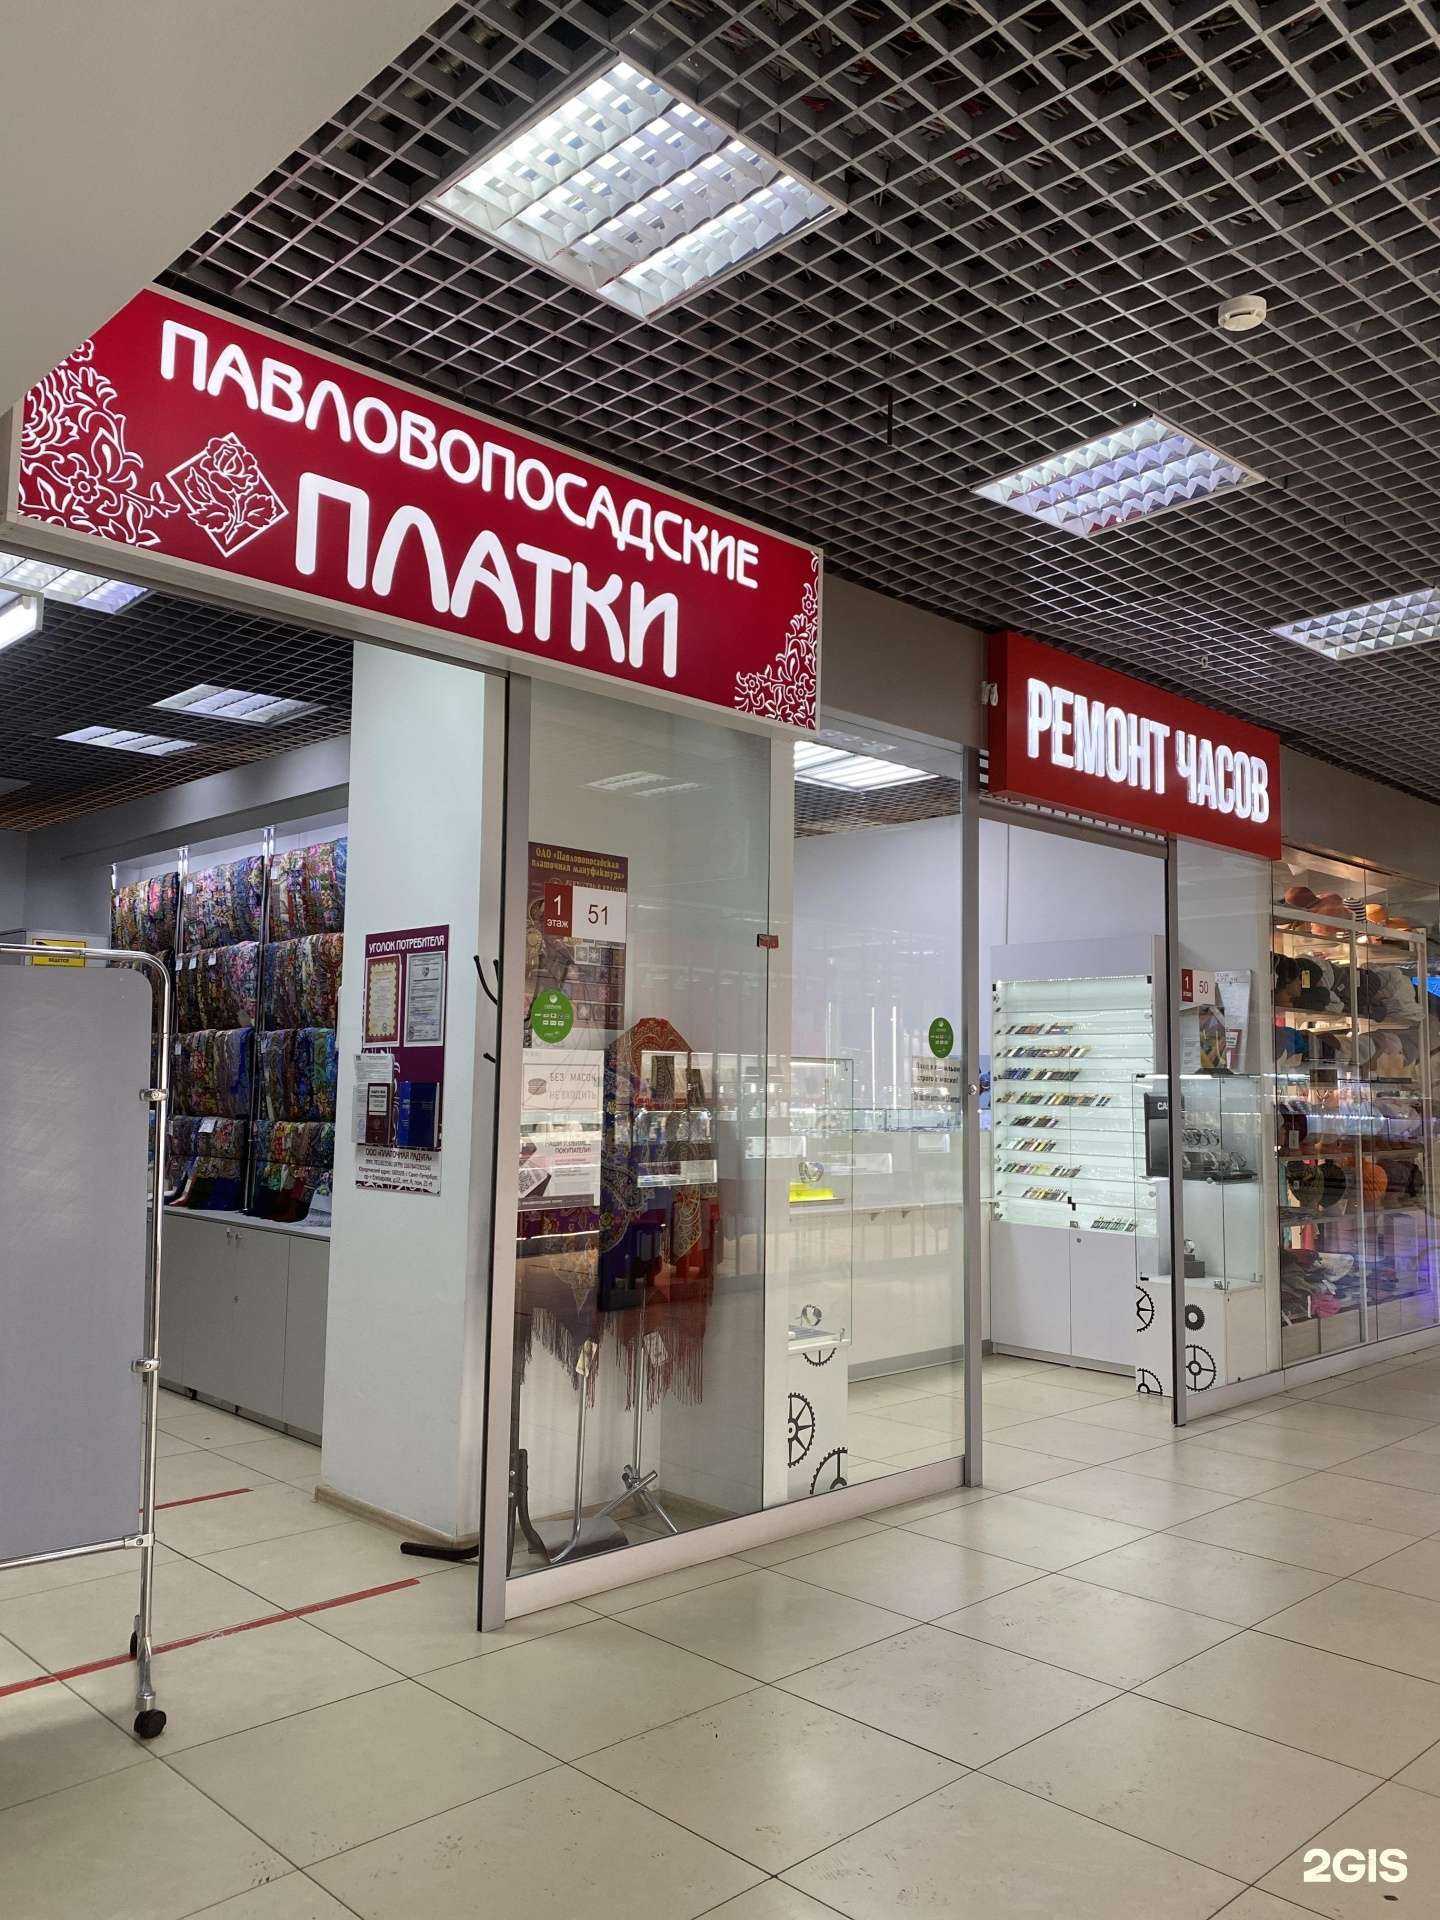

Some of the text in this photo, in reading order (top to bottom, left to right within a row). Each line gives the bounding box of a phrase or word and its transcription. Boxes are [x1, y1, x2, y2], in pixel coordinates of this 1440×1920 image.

[160, 319, 760, 590] ПАВЛОВОПОСАДСКИЕ
[294, 471, 679, 679] ПЛАТКИ
[1027, 677, 1271, 825] РЕМОНТ ЧАСОВ
[535, 847, 552, 859] ОАО
[553, 894, 562, 916] 1
[587, 903, 609, 926] 51
[546, 918, 569, 929] этаж
[368, 934, 445, 954] УГОЛОК ПОТРЕБИТЕЛЯ
[1184, 976, 1189, 990] 1
[1199, 981, 1209, 994] 50
